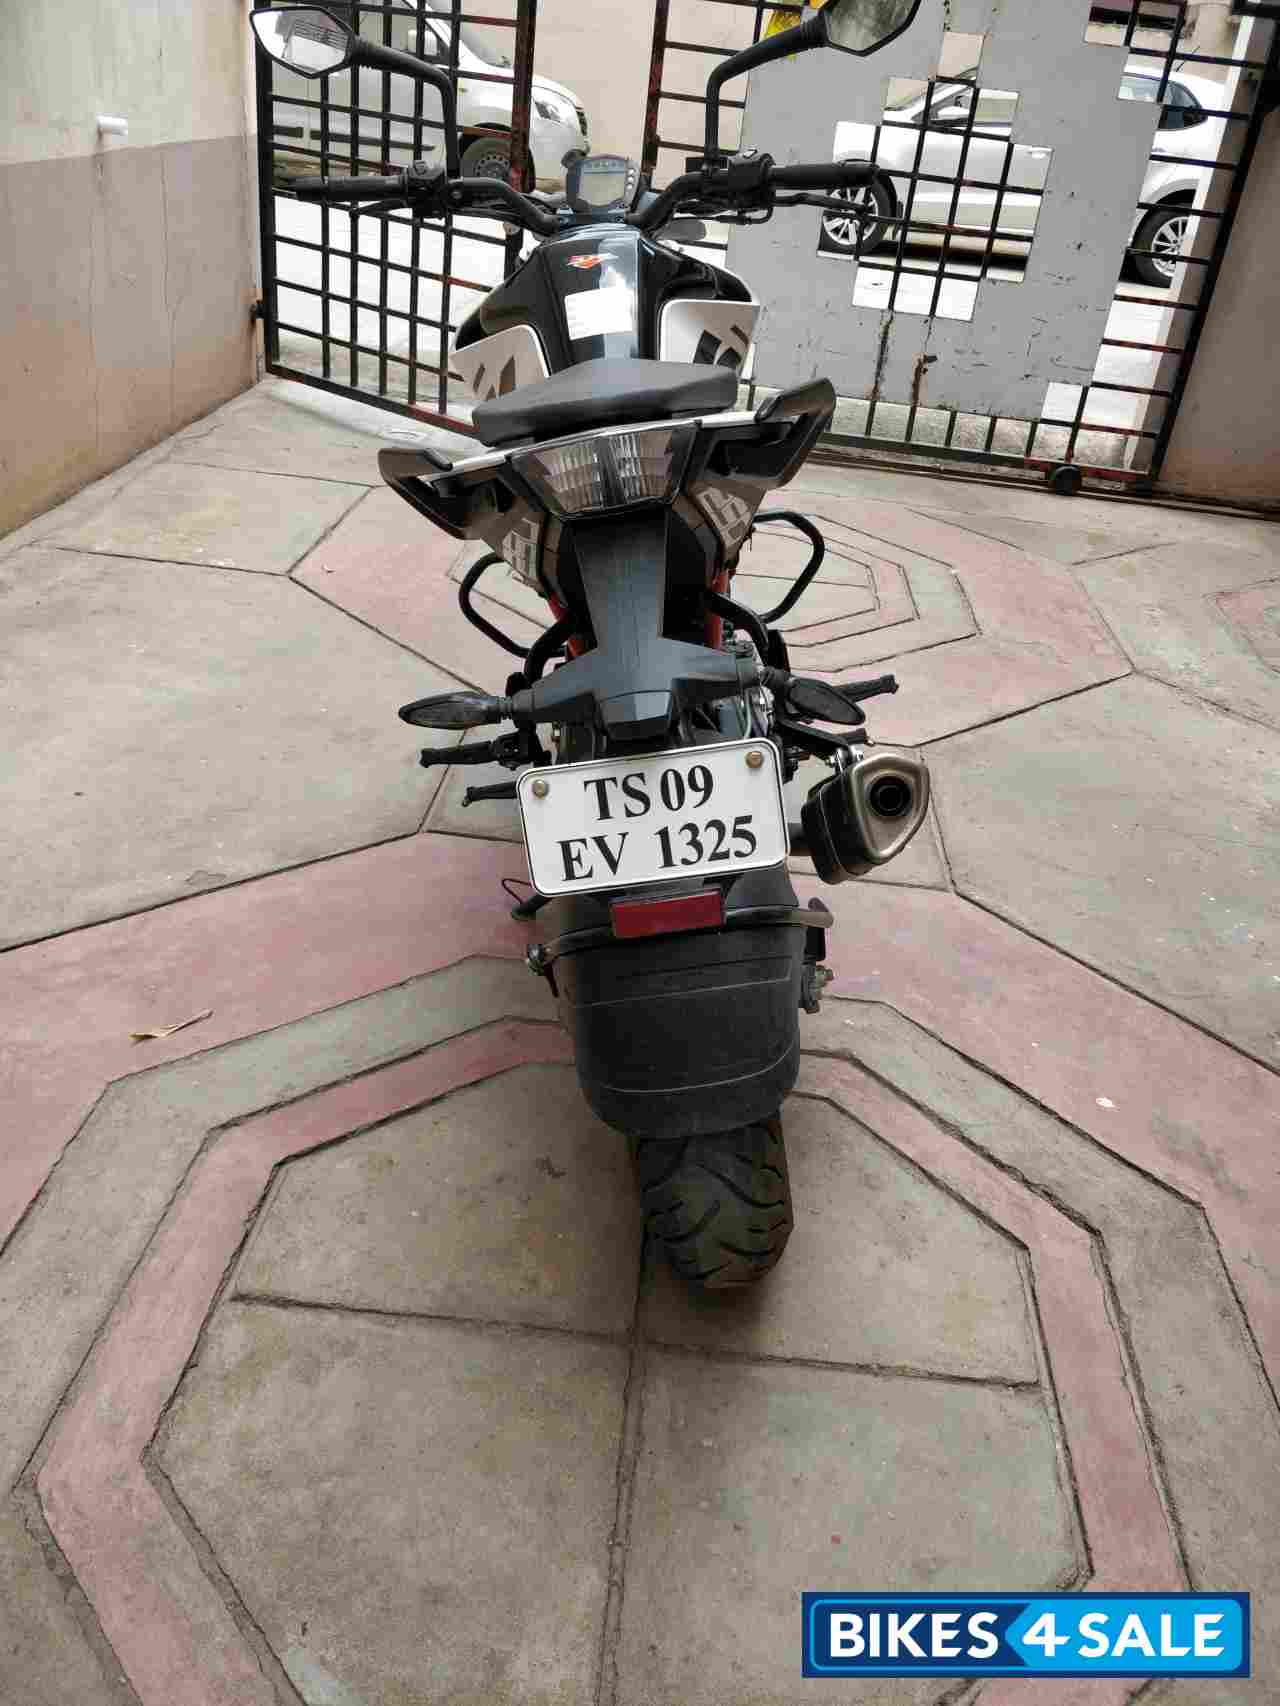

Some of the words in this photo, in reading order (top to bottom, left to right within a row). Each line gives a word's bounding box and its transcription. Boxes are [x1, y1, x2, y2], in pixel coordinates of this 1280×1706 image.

[583, 772, 651, 821] TS
[660, 764, 714, 812] 09
[556, 831, 629, 882] EV
[653, 815, 758, 869] 1325
